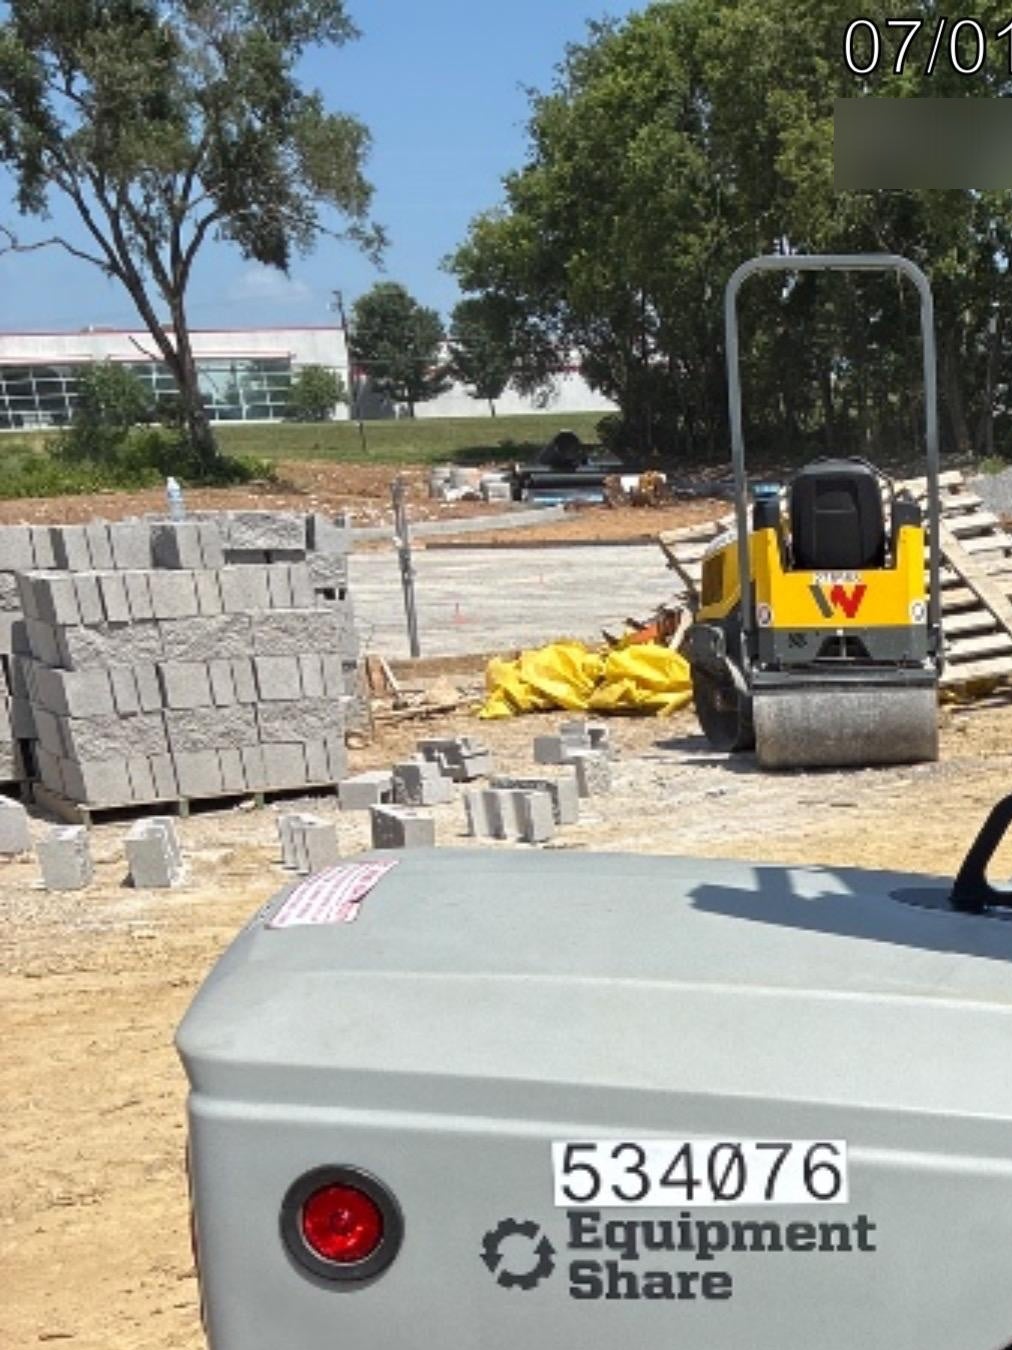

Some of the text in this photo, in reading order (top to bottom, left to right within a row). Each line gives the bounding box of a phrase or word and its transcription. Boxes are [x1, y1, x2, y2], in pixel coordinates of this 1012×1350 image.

[561, 1142, 842, 1202] 534076
[566, 1211, 876, 1260] Equipment
[569, 1260, 733, 1300] Share
